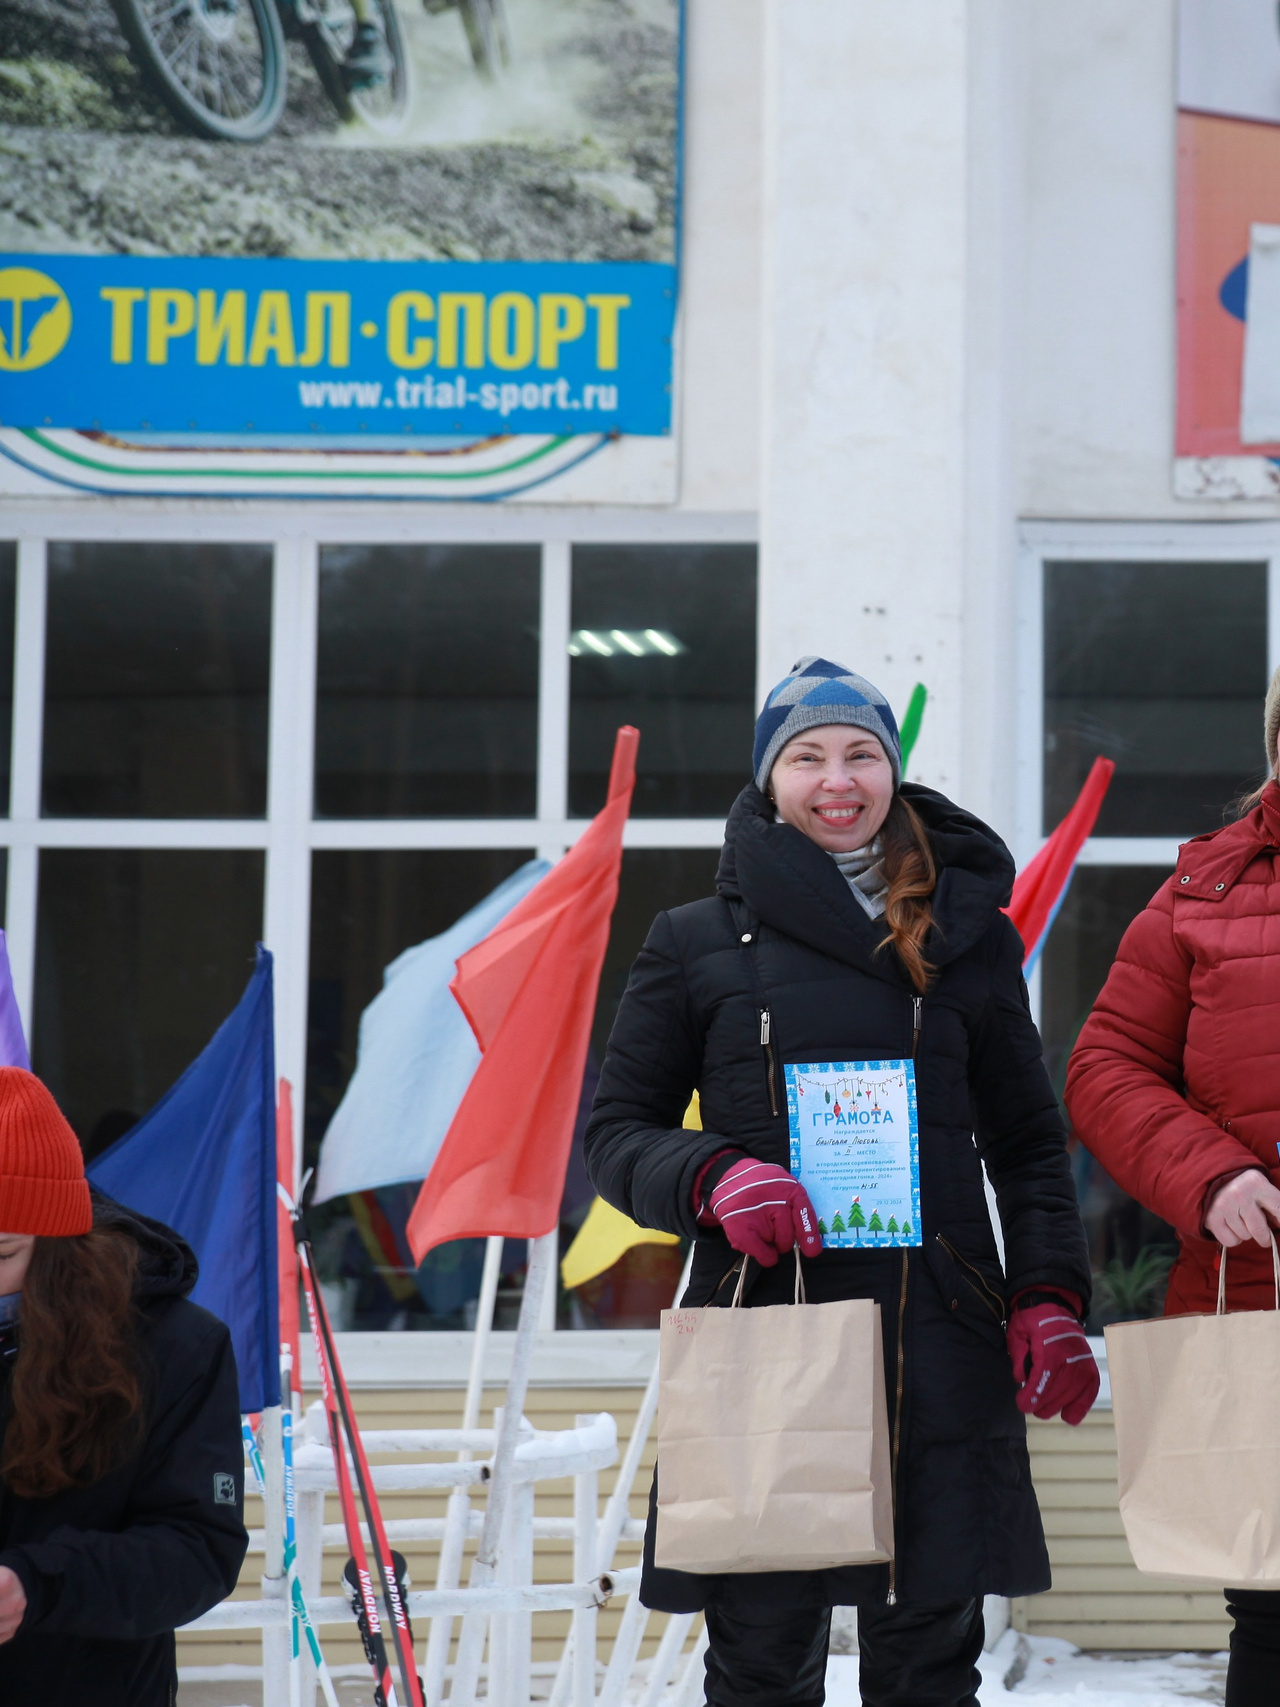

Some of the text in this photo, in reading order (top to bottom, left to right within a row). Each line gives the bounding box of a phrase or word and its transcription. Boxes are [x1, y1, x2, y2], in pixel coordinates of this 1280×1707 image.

[299, 375, 618, 416] www.trial-sport.ru
[812, 1110, 894, 1127] ГРАМОТА
[834, 1128, 875, 1136] Награждается
[854, 1166, 906, 1175] ориентированию
[840, 1184, 860, 1192] группе
[358, 1568, 382, 1633] NORDWAY
[383, 1565, 407, 1630] NORDWAY
